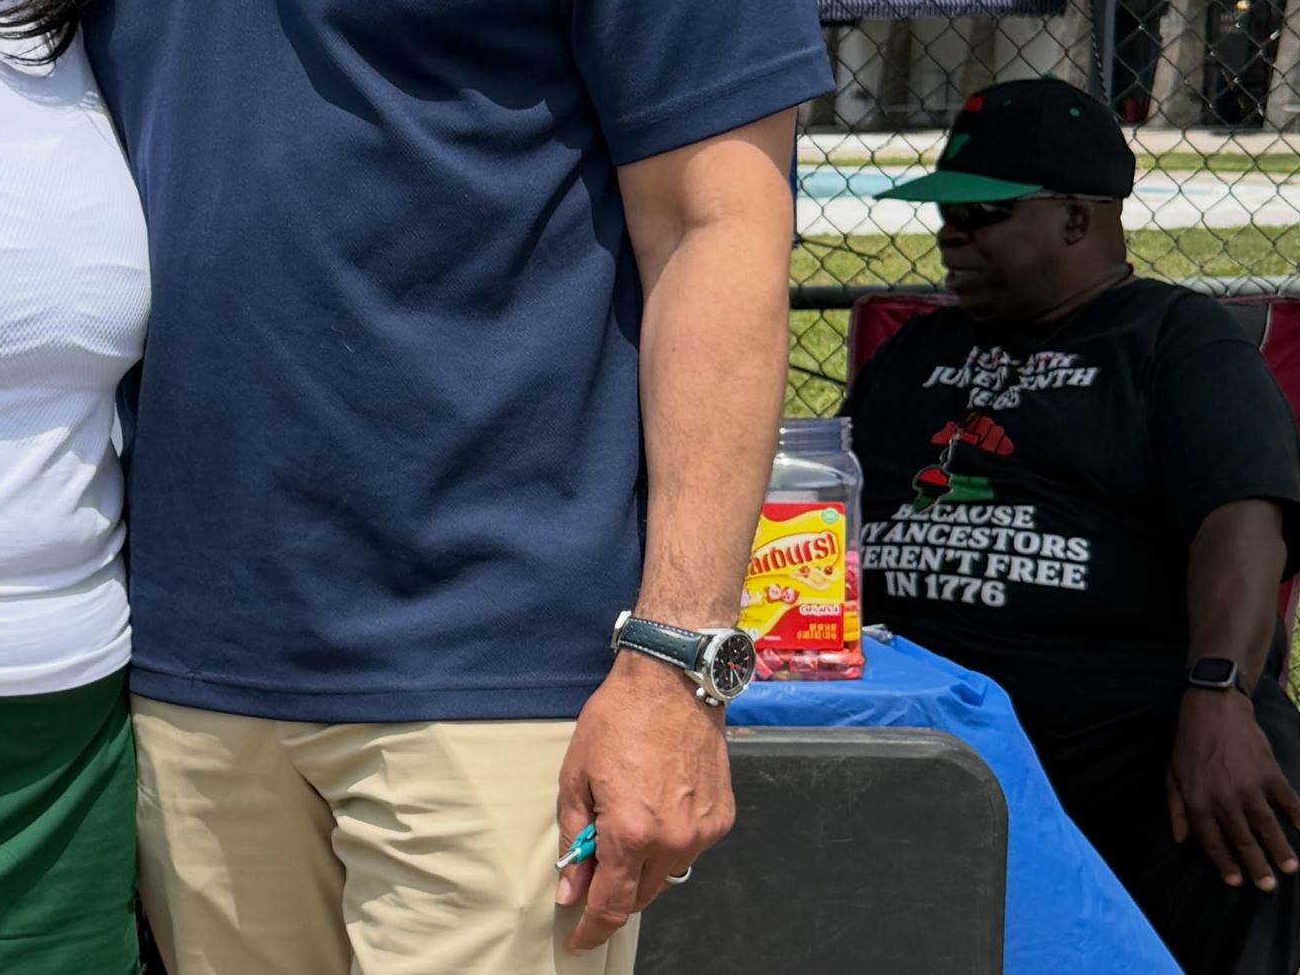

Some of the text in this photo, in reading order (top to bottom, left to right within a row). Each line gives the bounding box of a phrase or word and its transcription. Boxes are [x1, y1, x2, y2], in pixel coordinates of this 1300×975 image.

[882, 521, 1090, 563] ANCESTORS
[861, 544, 1087, 591] EREN'T FREE
[884, 570, 1006, 607] IN 1776
